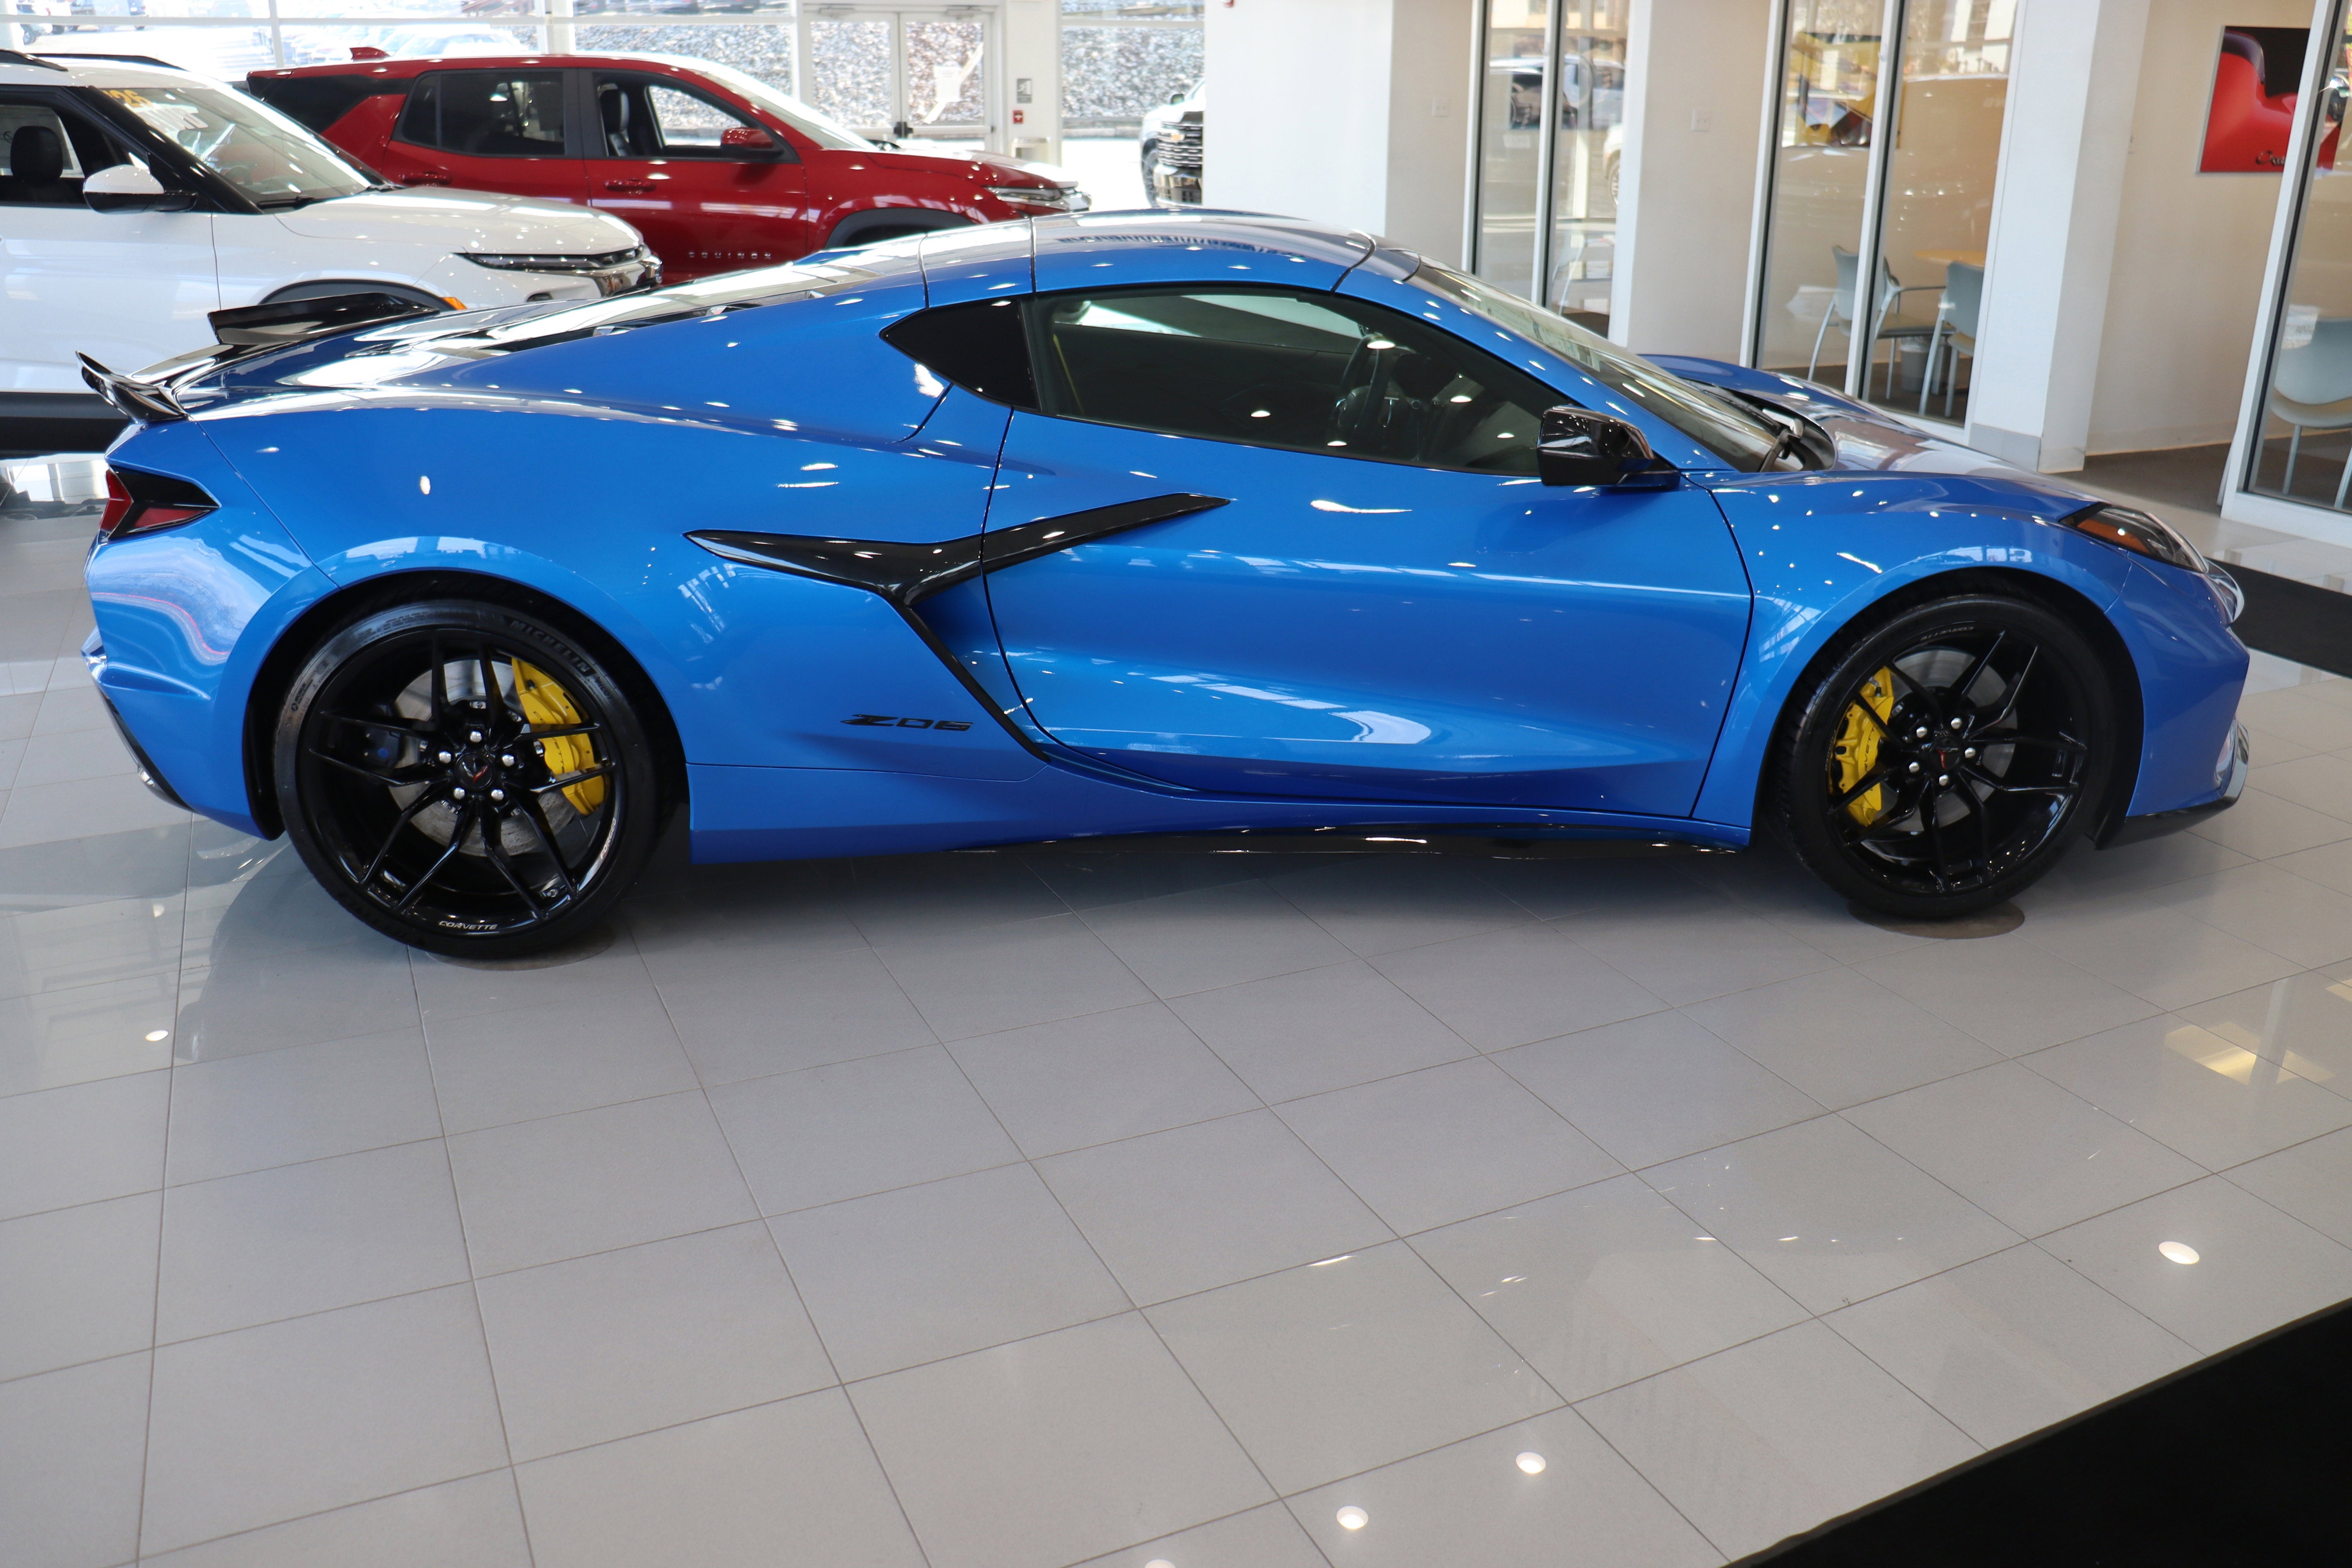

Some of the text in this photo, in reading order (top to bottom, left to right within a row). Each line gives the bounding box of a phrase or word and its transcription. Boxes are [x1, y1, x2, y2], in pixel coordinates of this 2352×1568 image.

[510, 620, 591, 673] MICHELIN
[840, 714, 973, 731] Z06
[600, 817, 616, 860] FORGED
[438, 920, 498, 930] CORVETTE
